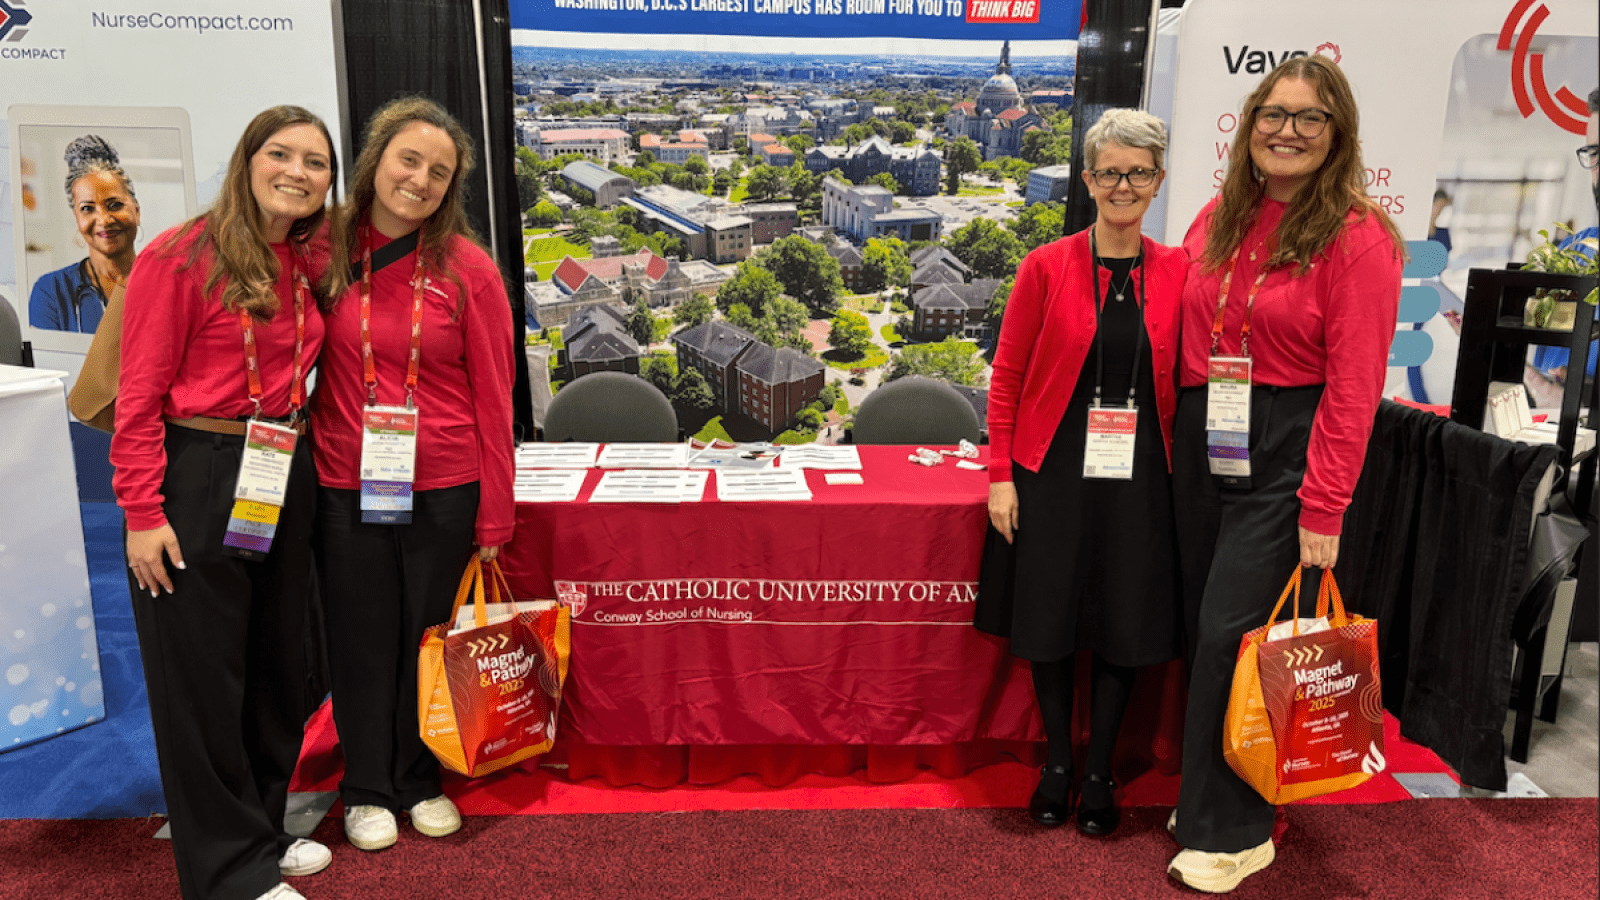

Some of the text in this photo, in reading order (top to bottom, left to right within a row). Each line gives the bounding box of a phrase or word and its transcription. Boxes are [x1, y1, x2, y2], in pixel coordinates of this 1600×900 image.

[555, 0, 649, 12] WASHINGTON,
[691, 0, 749, 13] LARGEST
[754, 0, 811, 15] CAMPUS
[815, 0, 842, 15] HAS
[846, 0, 885, 15] ROOM
[888, 0, 914, 15] FOR
[917, 0, 943, 16] YOU
[945, 0, 962, 17] TO
[971, 1, 1036, 18] THINK BIG
[92, 12, 293, 34] NurseCompact.com
[1, 48, 66, 60] COMPACT
[592, 583, 624, 597] THE
[625, 580, 751, 603] CATHOLIC
[759, 581, 906, 602] UNIVERSITY
[908, 582, 942, 603] OF
[593, 605, 754, 624] Conway School of Nursing
[479, 672, 494, 688] &
[1293, 659, 1343, 685] Magnet
[1294, 673, 1362, 701] & Pathway
[1308, 695, 1336, 712] 2025
